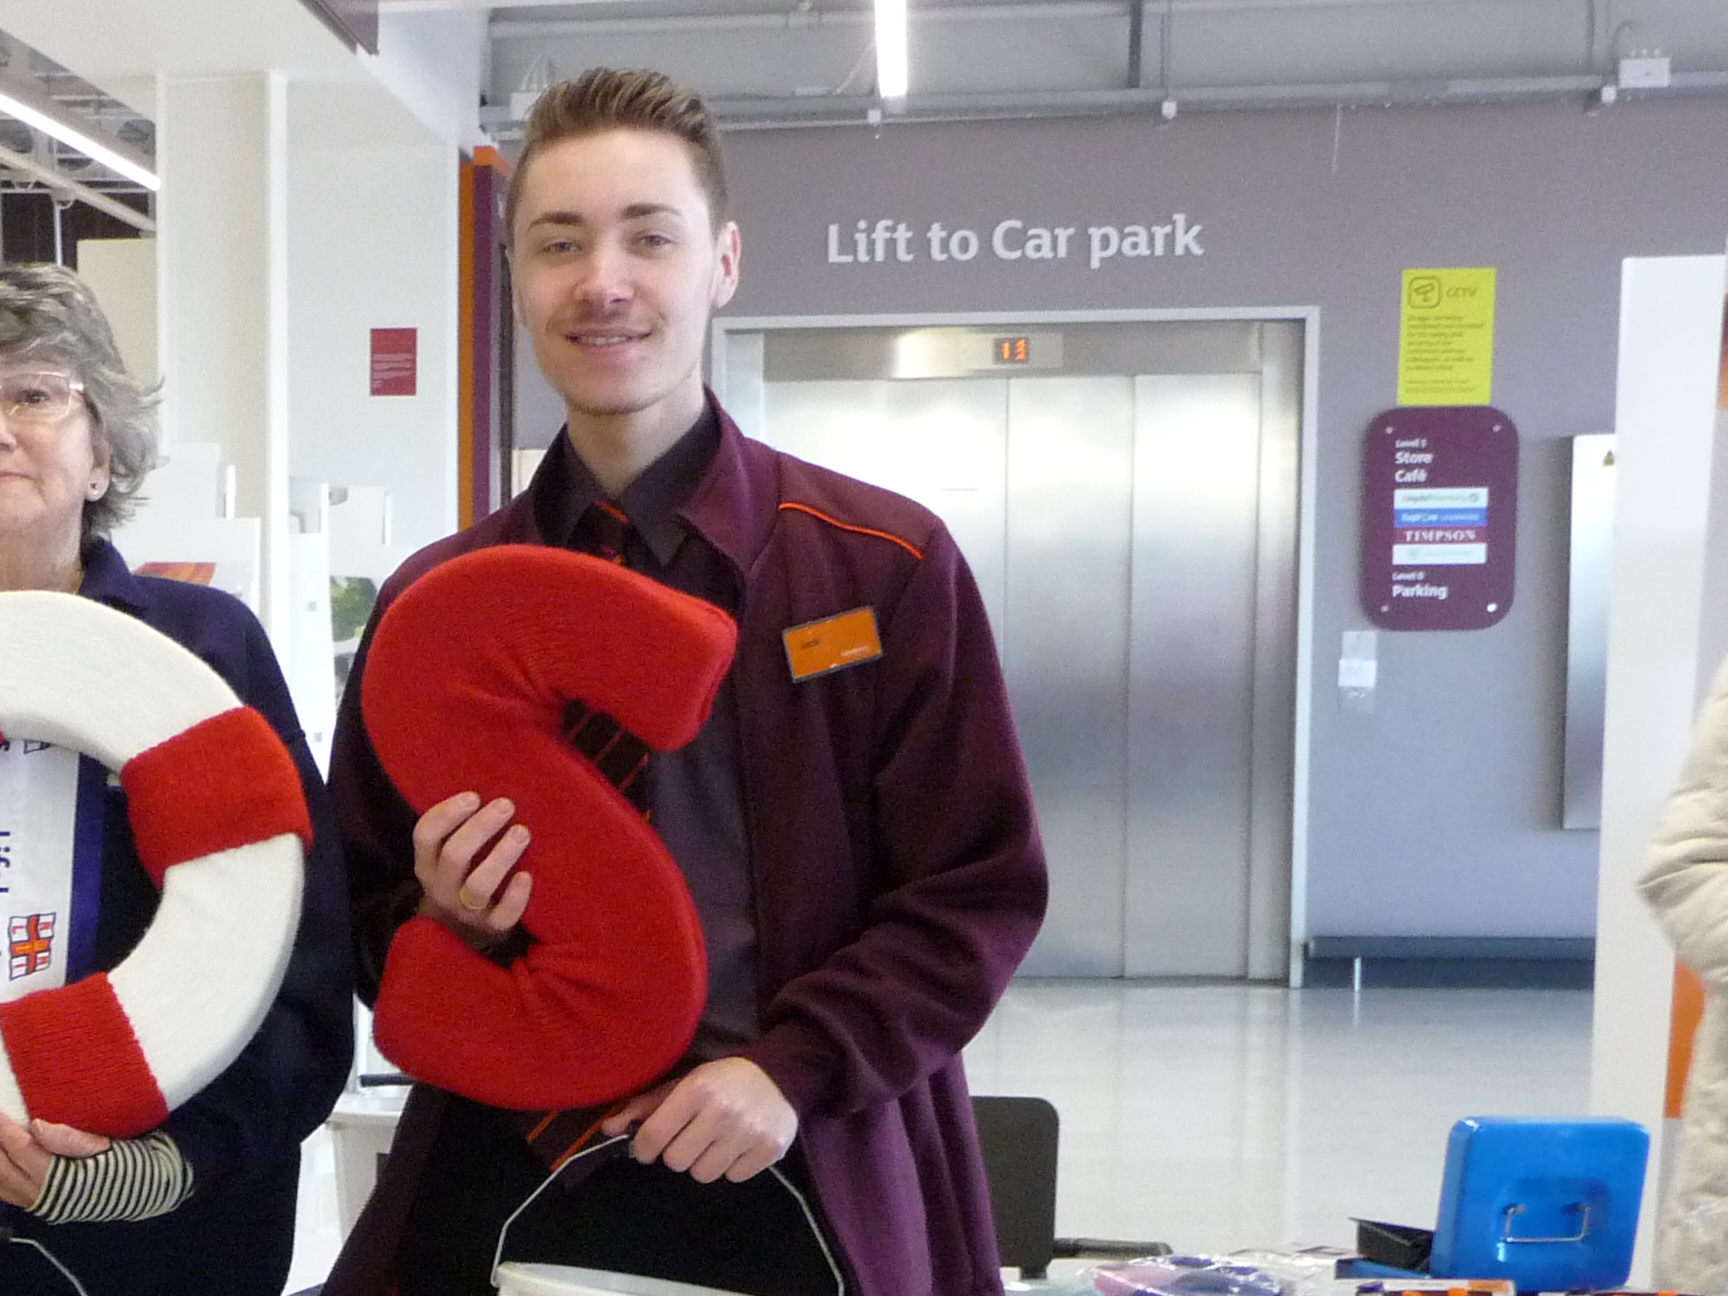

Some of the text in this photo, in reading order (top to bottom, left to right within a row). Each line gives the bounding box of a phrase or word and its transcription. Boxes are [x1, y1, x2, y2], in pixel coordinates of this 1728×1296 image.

[827, 213, 1205, 270] Lift to Car park
[1394, 451, 1434, 465] Store
[1394, 468, 1428, 483] Café
[1404, 530, 1477, 542] TIMPSON
[1392, 585, 1449, 600] Parking
